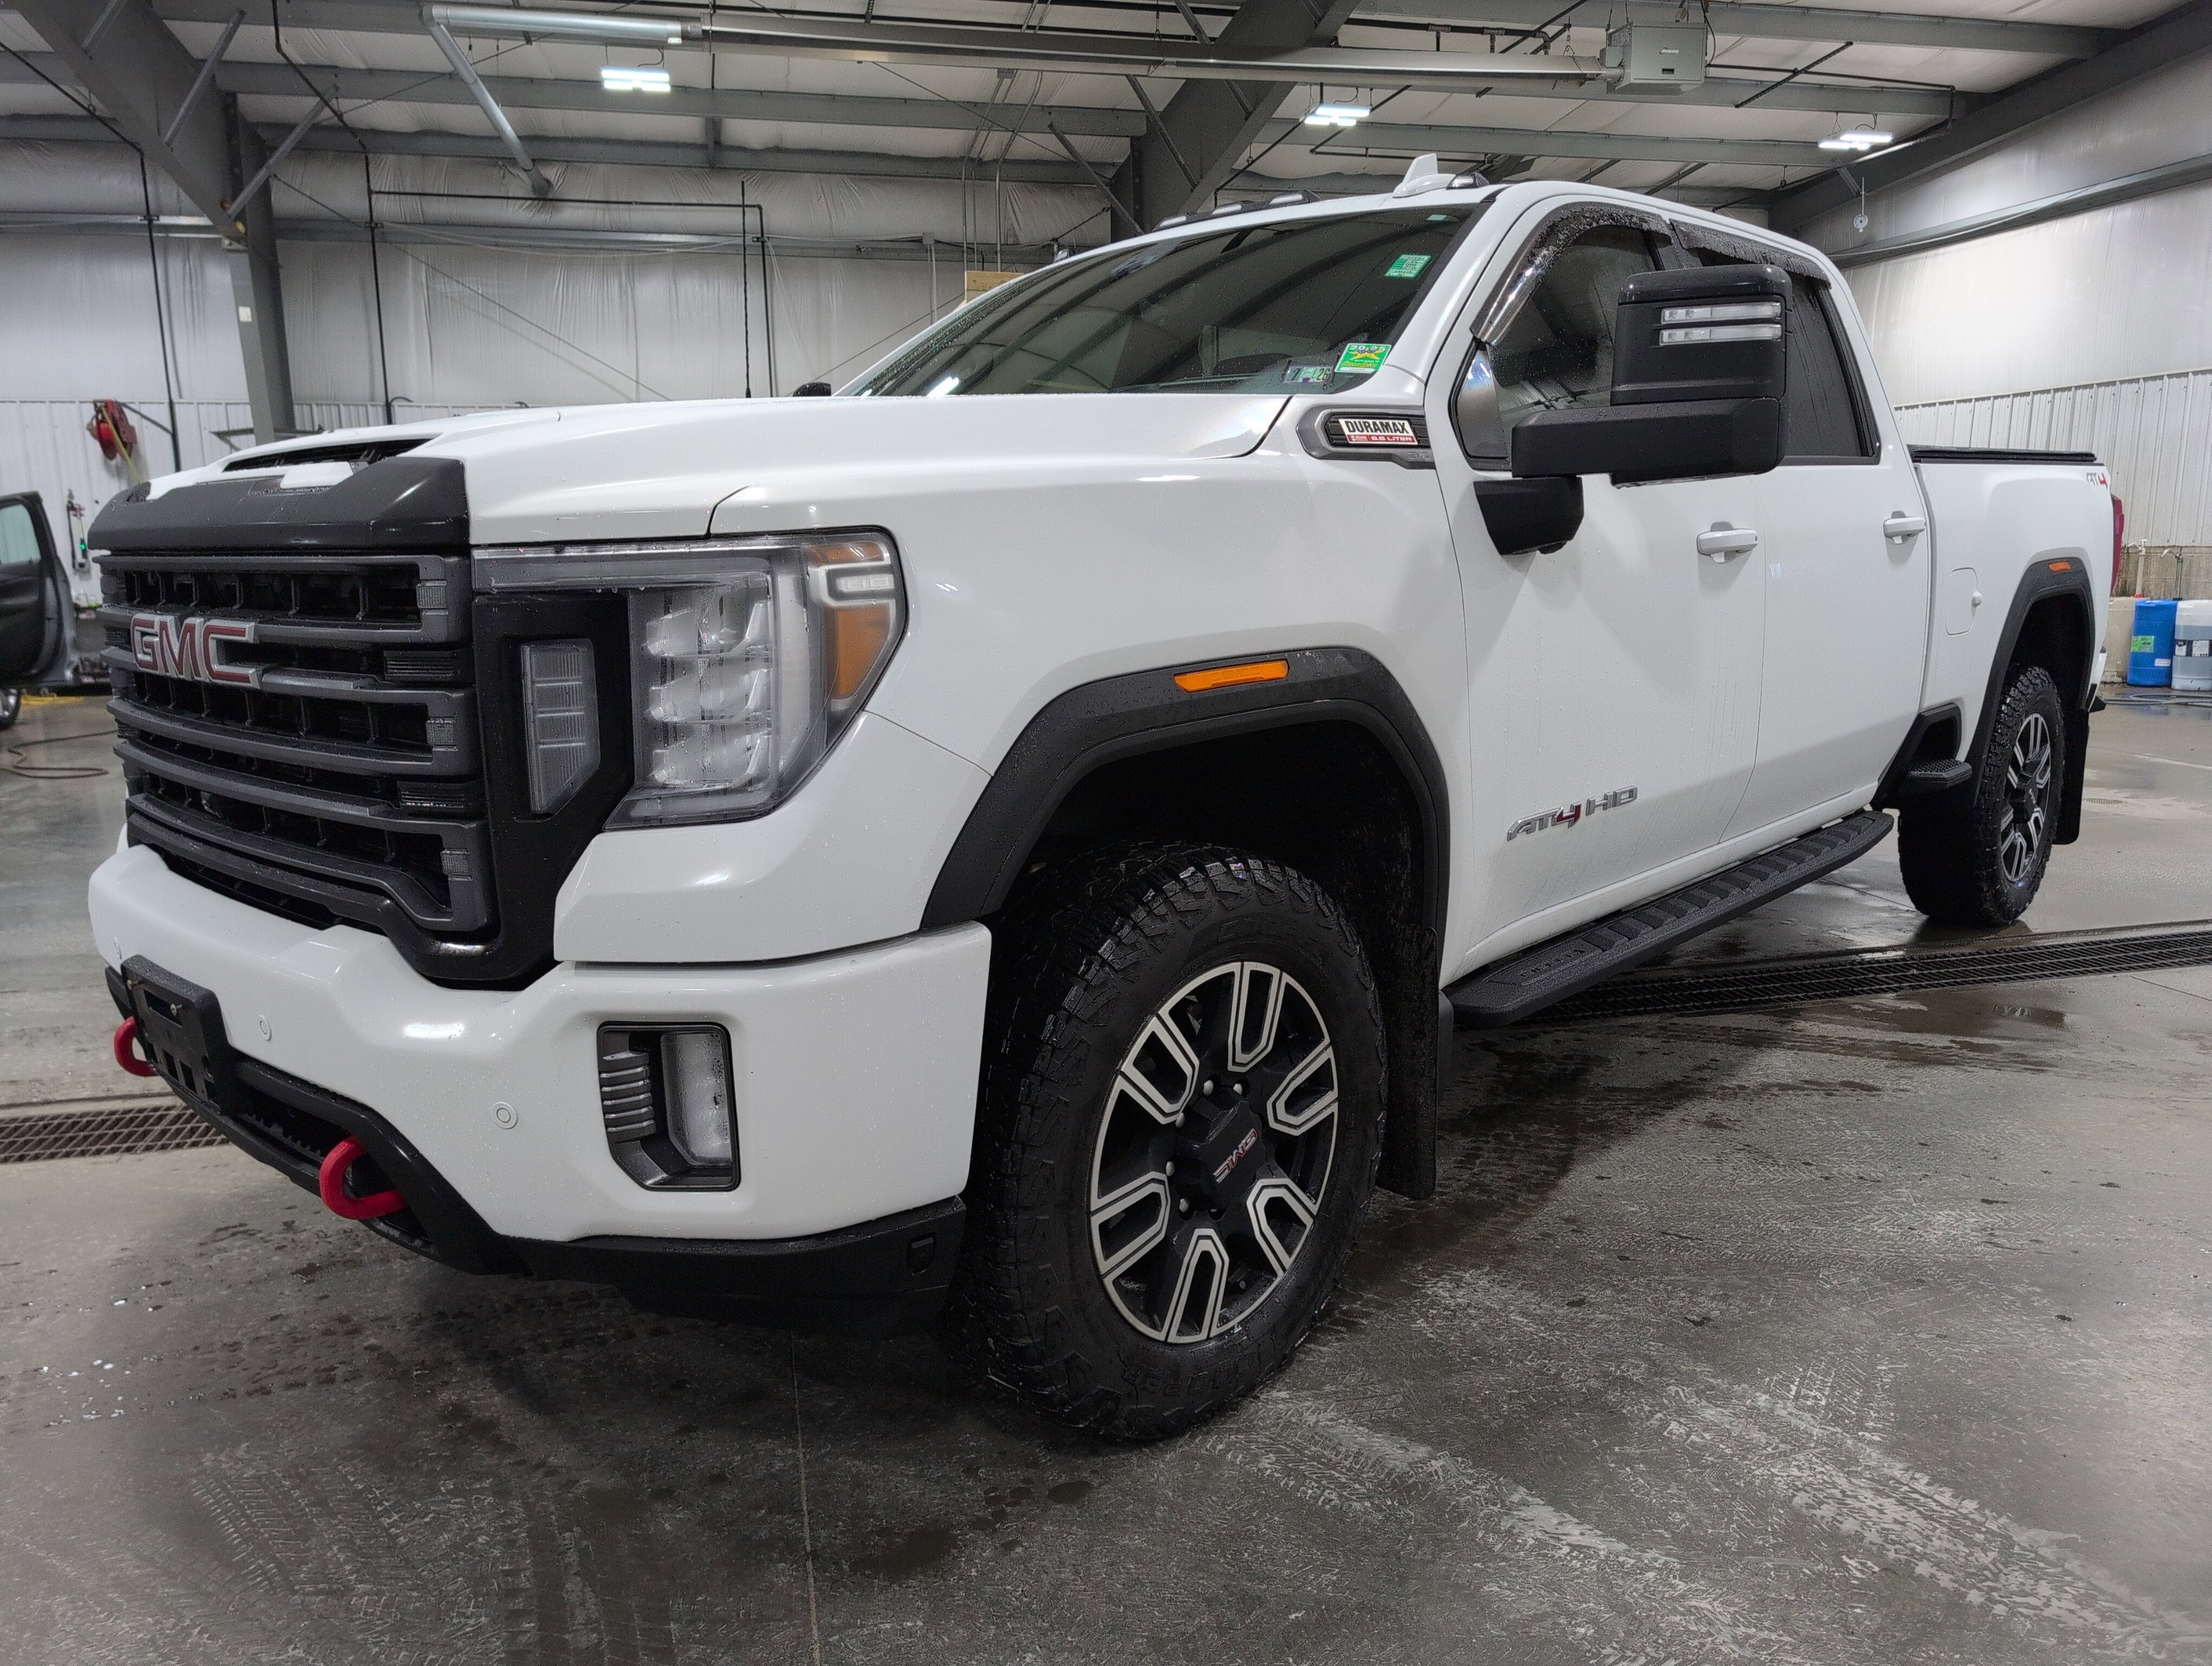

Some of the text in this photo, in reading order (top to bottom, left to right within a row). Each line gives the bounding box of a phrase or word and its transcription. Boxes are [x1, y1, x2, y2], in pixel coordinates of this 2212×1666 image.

[1344, 420, 1410, 434] DURAMAX
[130, 613, 261, 689] GMC
[1507, 785, 1638, 842] AT4 HD
[1213, 1128, 1258, 1184] GMC
